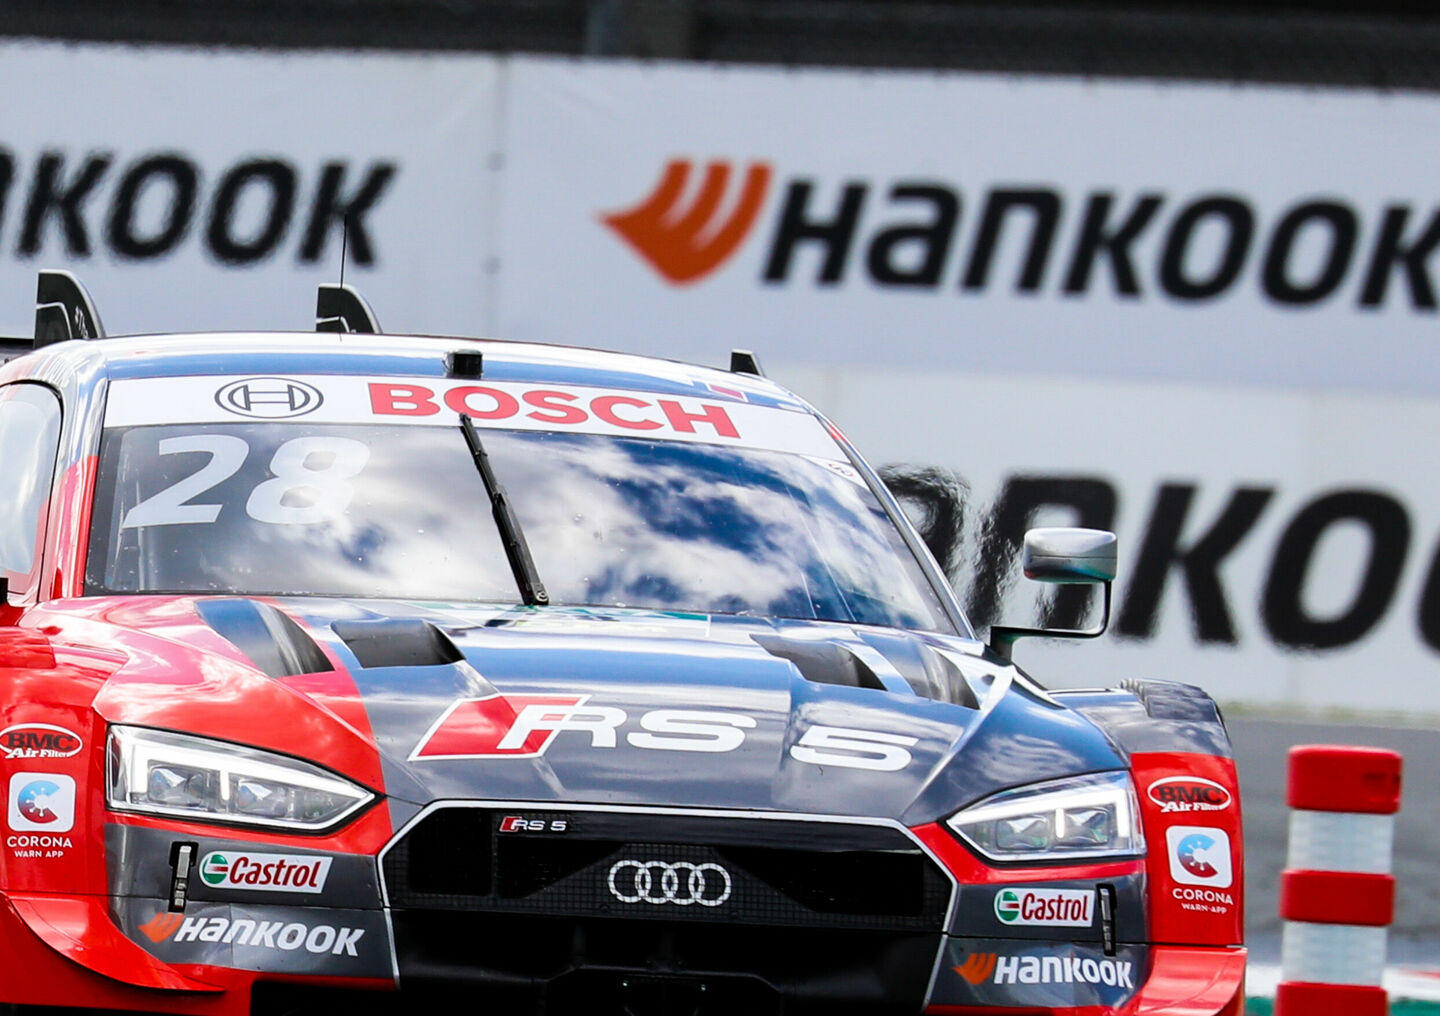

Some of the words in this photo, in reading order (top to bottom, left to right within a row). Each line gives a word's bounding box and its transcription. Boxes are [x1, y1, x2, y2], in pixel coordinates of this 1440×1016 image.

[367, 382, 741, 439] BOSCH
[120, 434, 372, 528] 28
[7, 731, 74, 751] BMC
[495, 704, 758, 754] RS
[789, 724, 920, 772] 5
[5, 747, 39, 759] Air
[1157, 785, 1222, 804] BMC
[1160, 801, 1192, 812] Air
[510, 819, 546, 831] RS
[550, 820, 567, 832] 5
[6, 835, 73, 848] CORONA
[14, 850, 42, 858] WARN
[229, 856, 321, 888] Castrol
[1172, 887, 1234, 905] CORONA
[1021, 892, 1088, 922] Castrol
